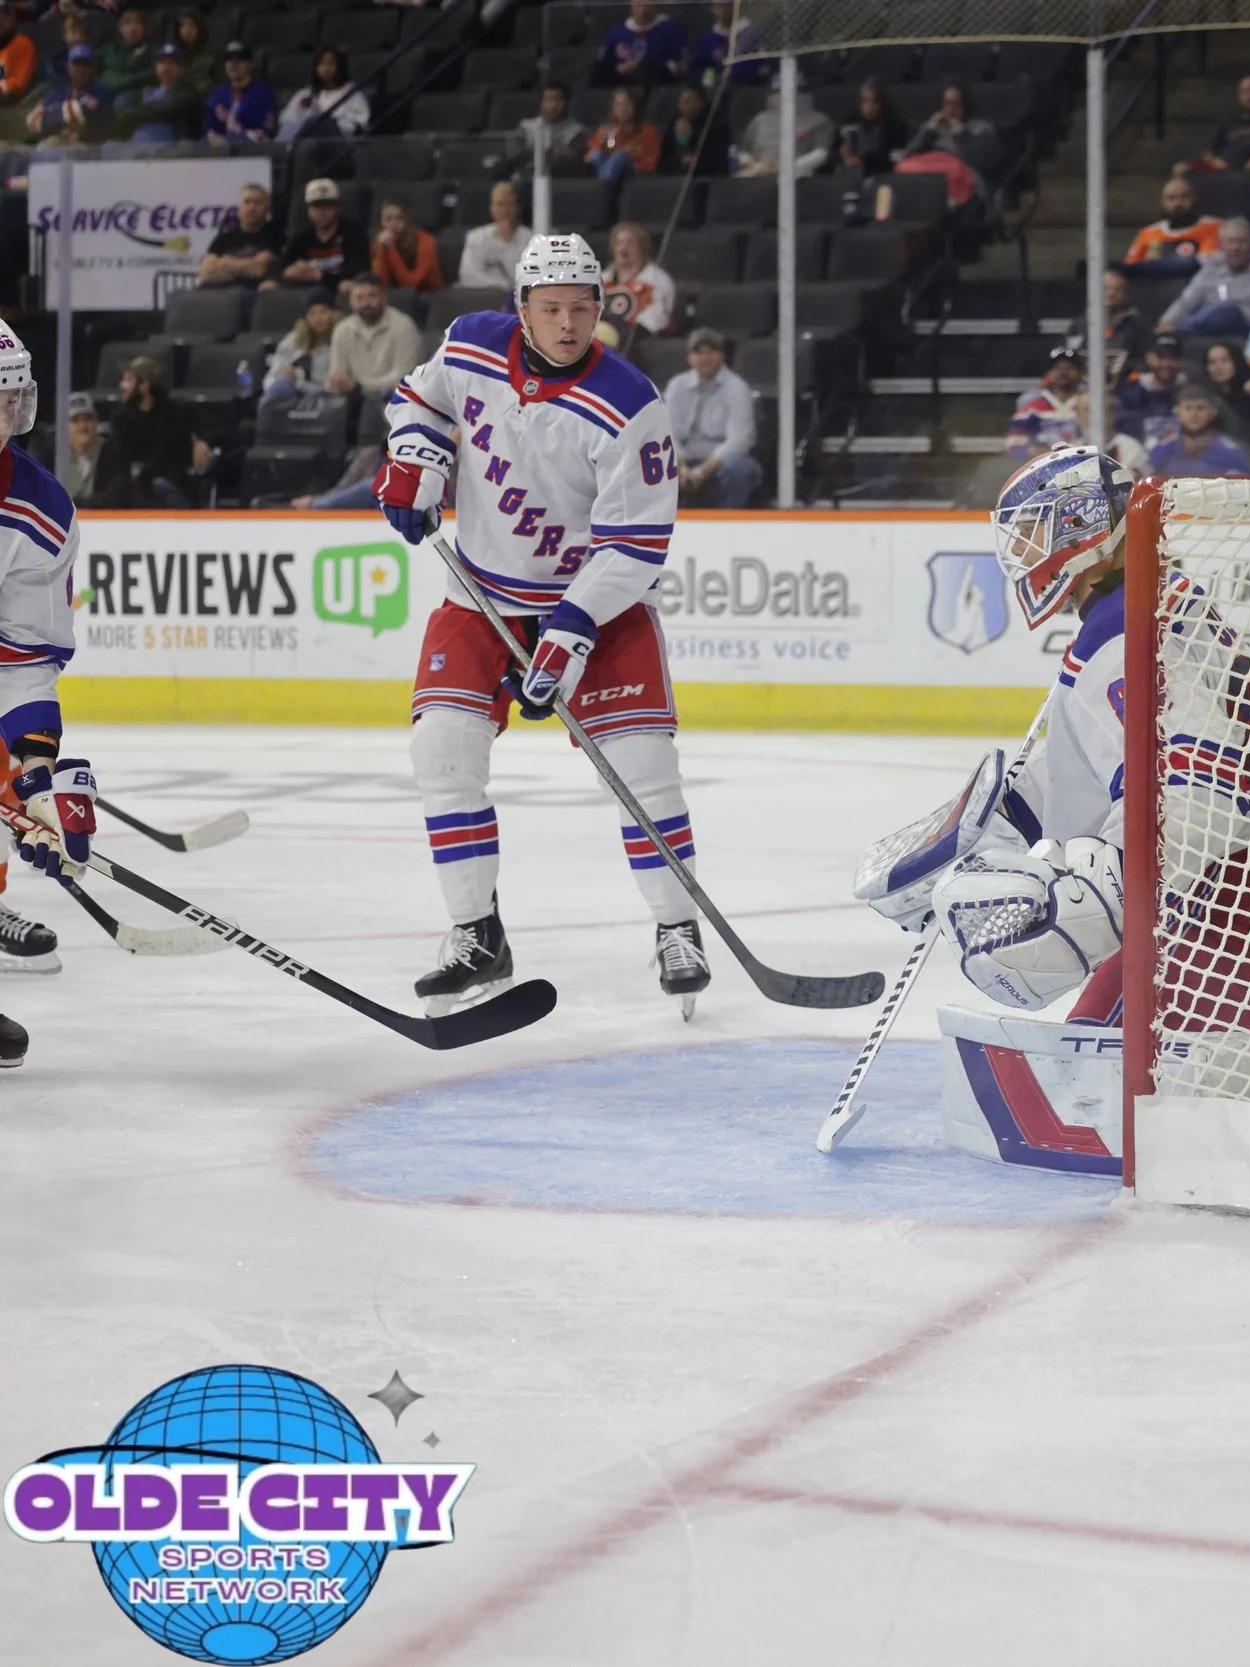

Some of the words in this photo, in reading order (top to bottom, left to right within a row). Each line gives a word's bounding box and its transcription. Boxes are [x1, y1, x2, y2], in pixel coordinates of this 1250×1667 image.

[396, 443, 451, 471] CCM
[463, 395, 589, 576] RANGERS
[89, 553, 298, 617] REVIEWS
[321, 554, 401, 619] UP
[87, 625, 138, 650] MORE
[144, 626, 156, 650] 5
[162, 626, 209, 650] STAR
[214, 626, 298, 651] REVIEWS
[772, 634, 851, 662] voice
[580, 683, 645, 707] CCM
[178, 904, 310, 981] BAUER
